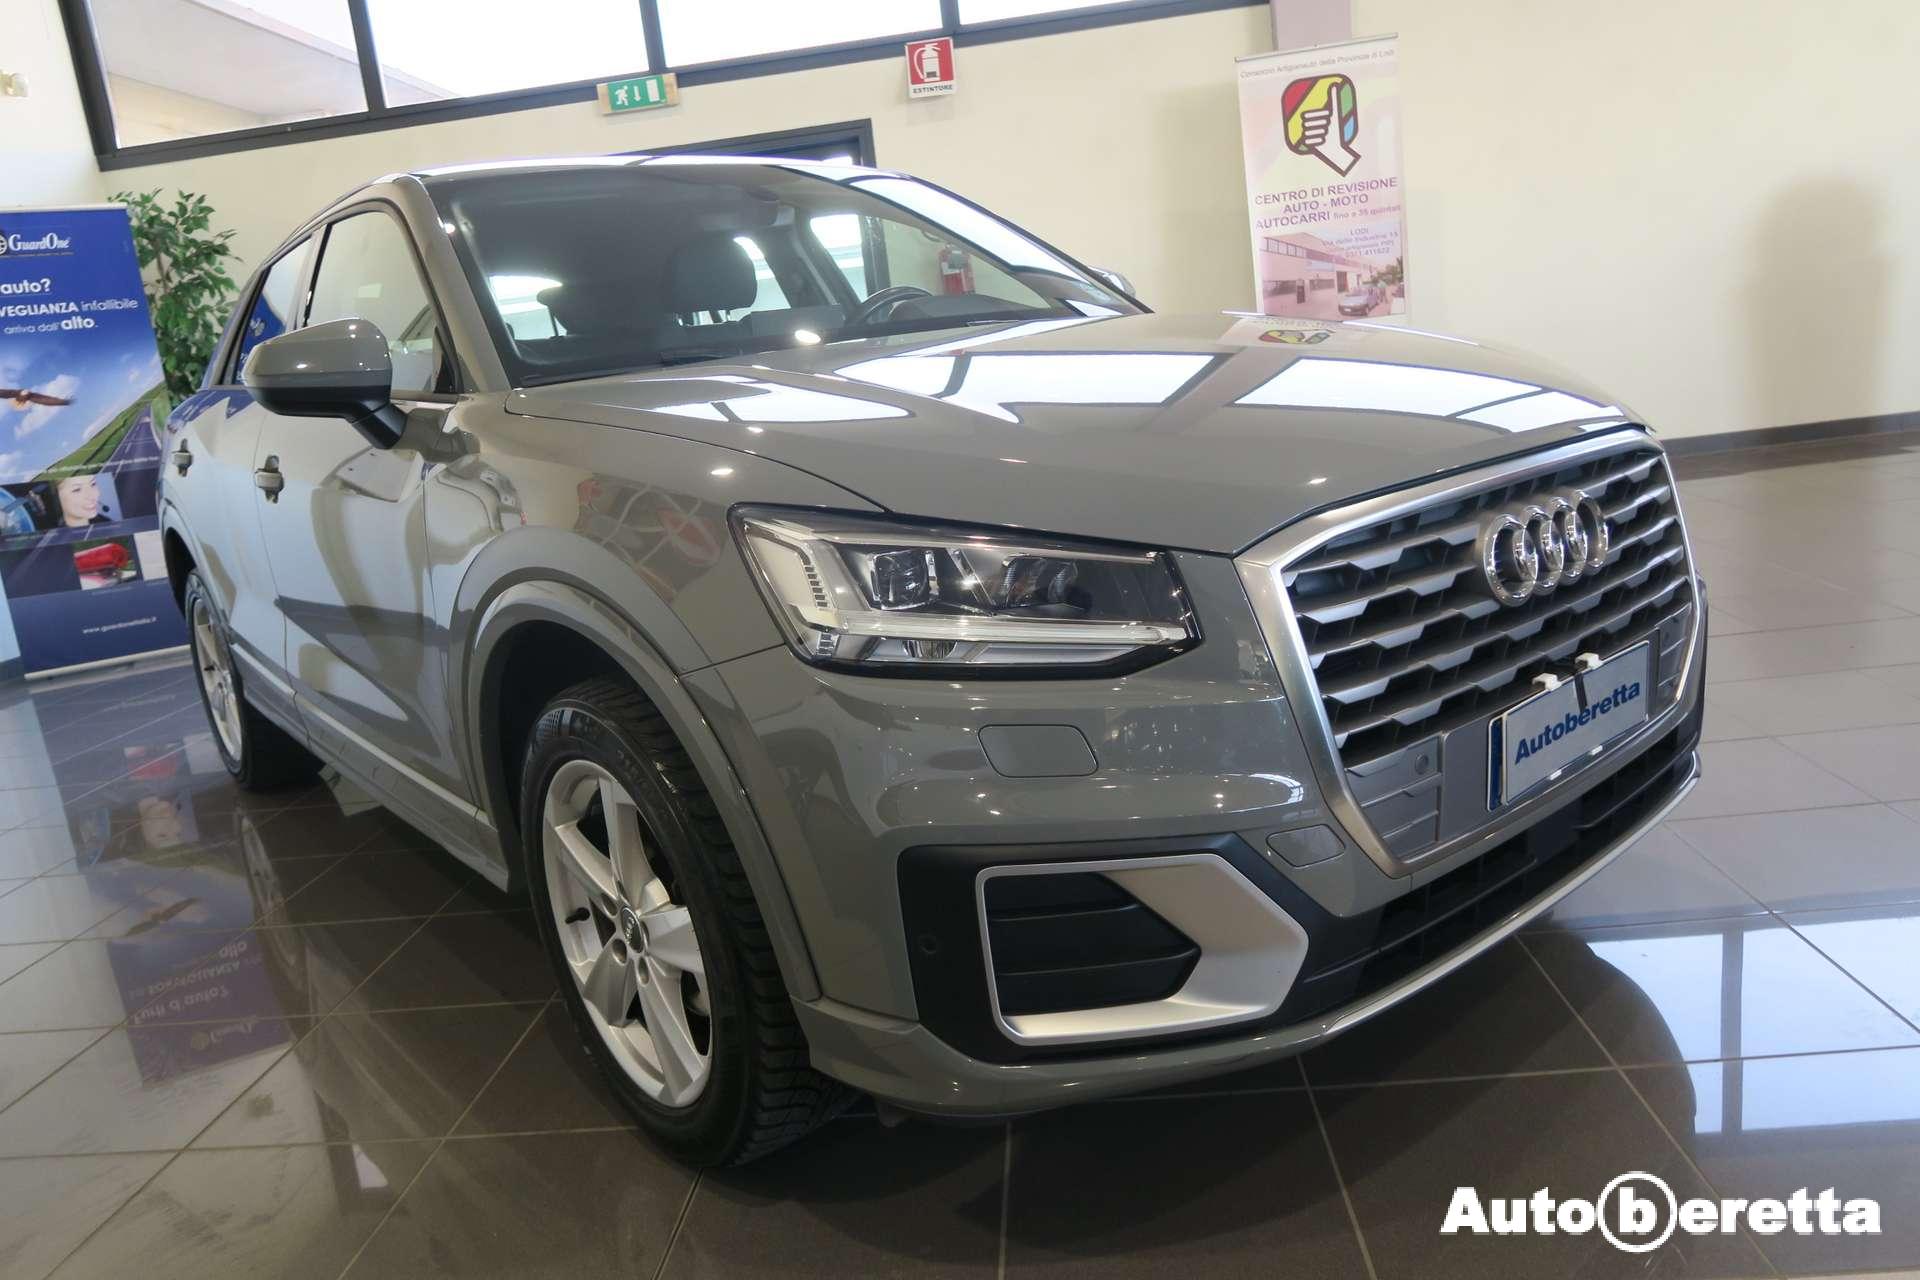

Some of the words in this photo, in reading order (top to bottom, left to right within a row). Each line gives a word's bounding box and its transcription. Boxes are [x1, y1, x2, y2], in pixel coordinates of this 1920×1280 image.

[912, 84, 952, 93] ESTINTORE
[1255, 189, 1307, 205] CENTRO
[1311, 187, 1324, 198] DI
[1327, 176, 1398, 195] REVISIONE
[1283, 200, 1319, 213] AUTO
[1330, 193, 1369, 207] MOTO
[1255, 211, 1330, 230] AUTOCARRI
[1350, 227, 1369, 236] LODI
[8, 232, 70, 251] GuardOne
[81, 298, 138, 312] infallibile
[4, 325, 36, 335] arriva
[1515, 681, 1641, 765] Autoberetta
